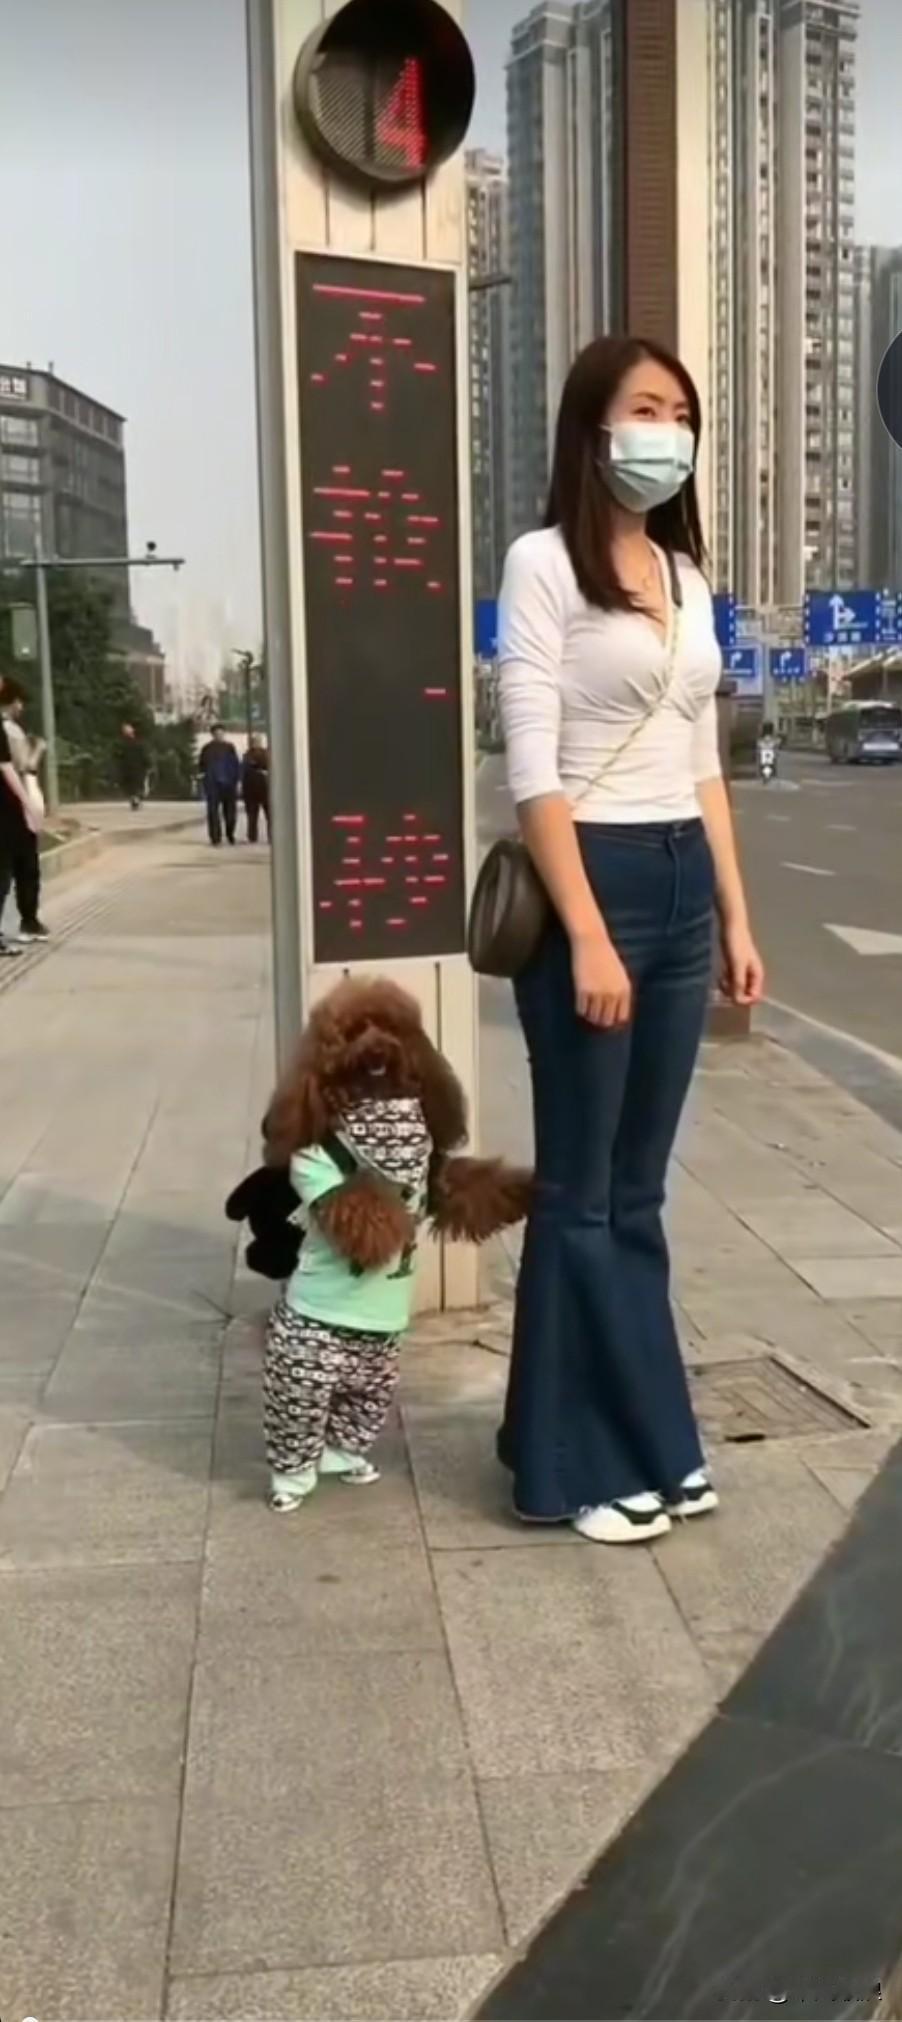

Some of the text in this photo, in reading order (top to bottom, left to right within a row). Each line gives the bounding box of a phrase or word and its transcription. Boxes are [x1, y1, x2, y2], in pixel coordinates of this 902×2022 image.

[376, 56, 427, 168] 4
[310, 283, 449, 929] 不抢秒
